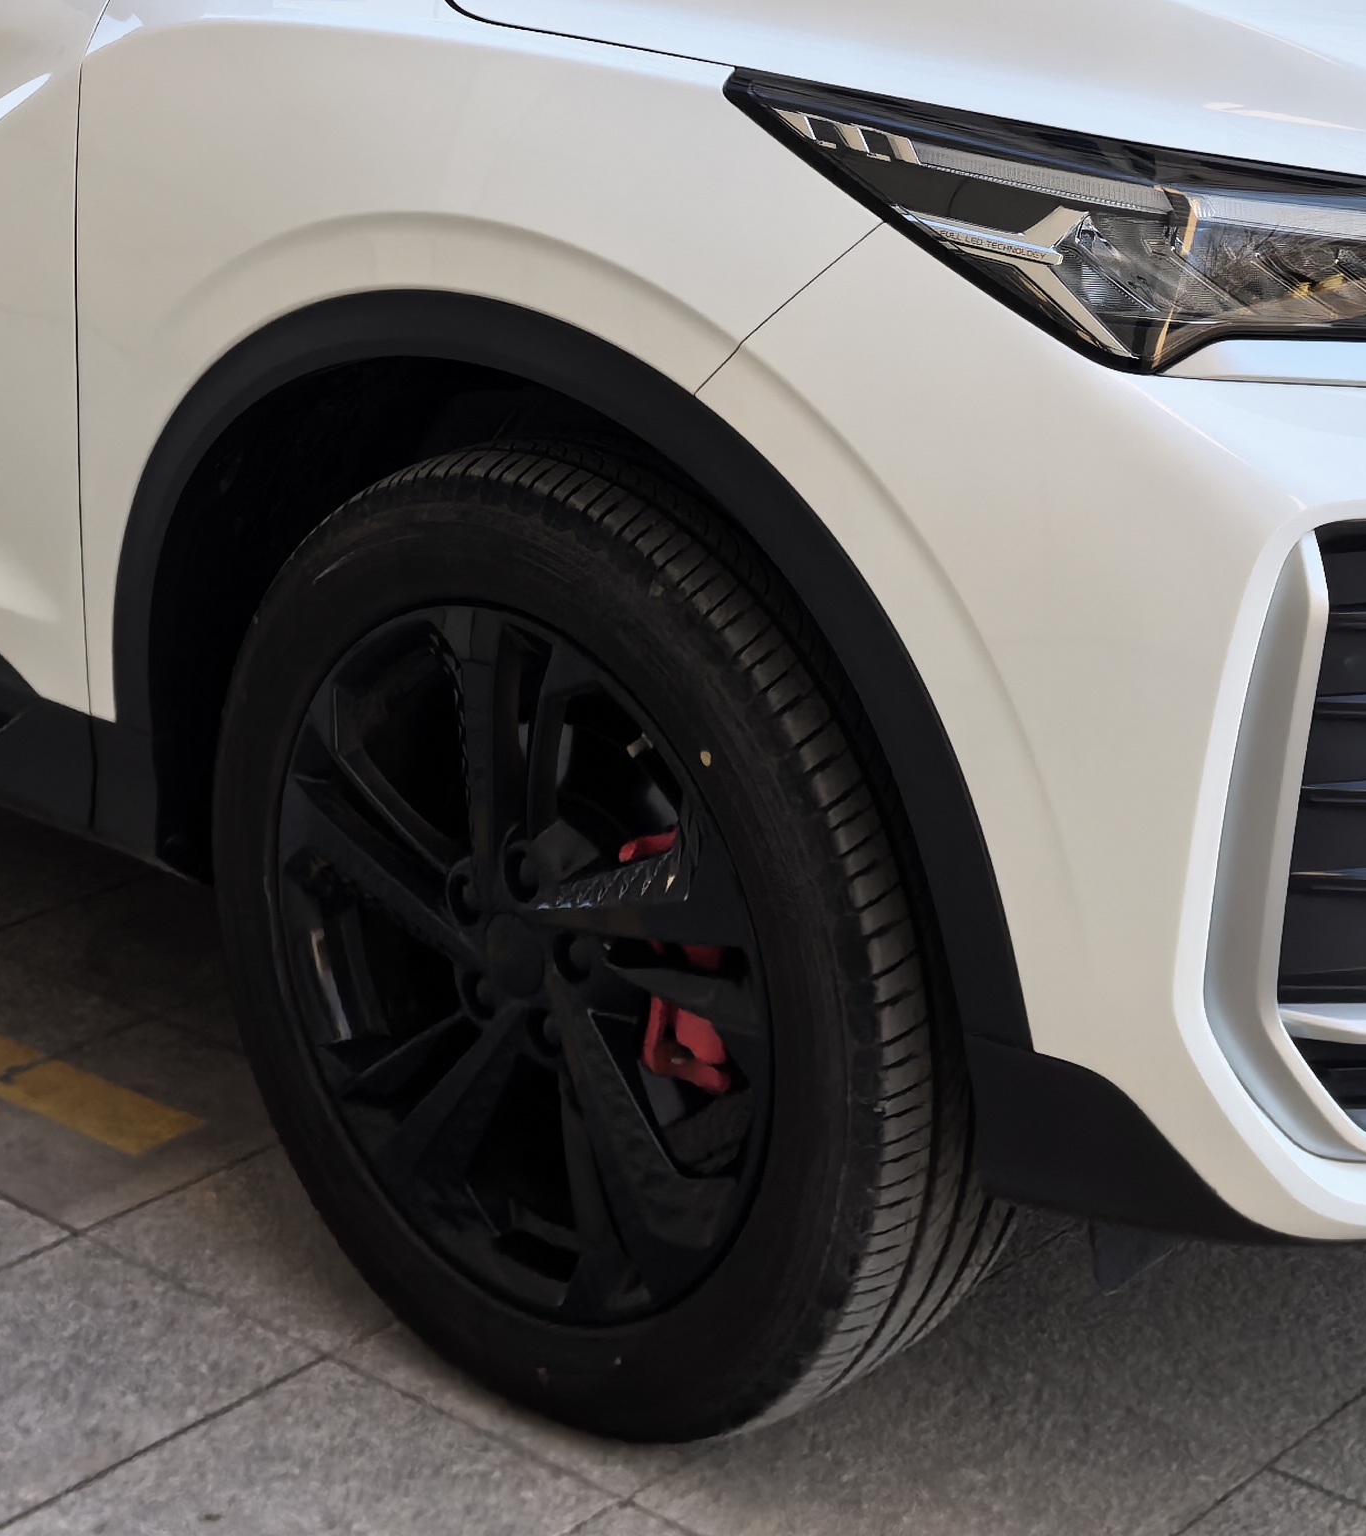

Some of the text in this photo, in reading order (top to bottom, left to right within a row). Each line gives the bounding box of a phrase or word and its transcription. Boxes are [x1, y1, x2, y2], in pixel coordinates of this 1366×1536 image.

[939, 230, 1047, 260] FULL LED TECHNOLOGY
